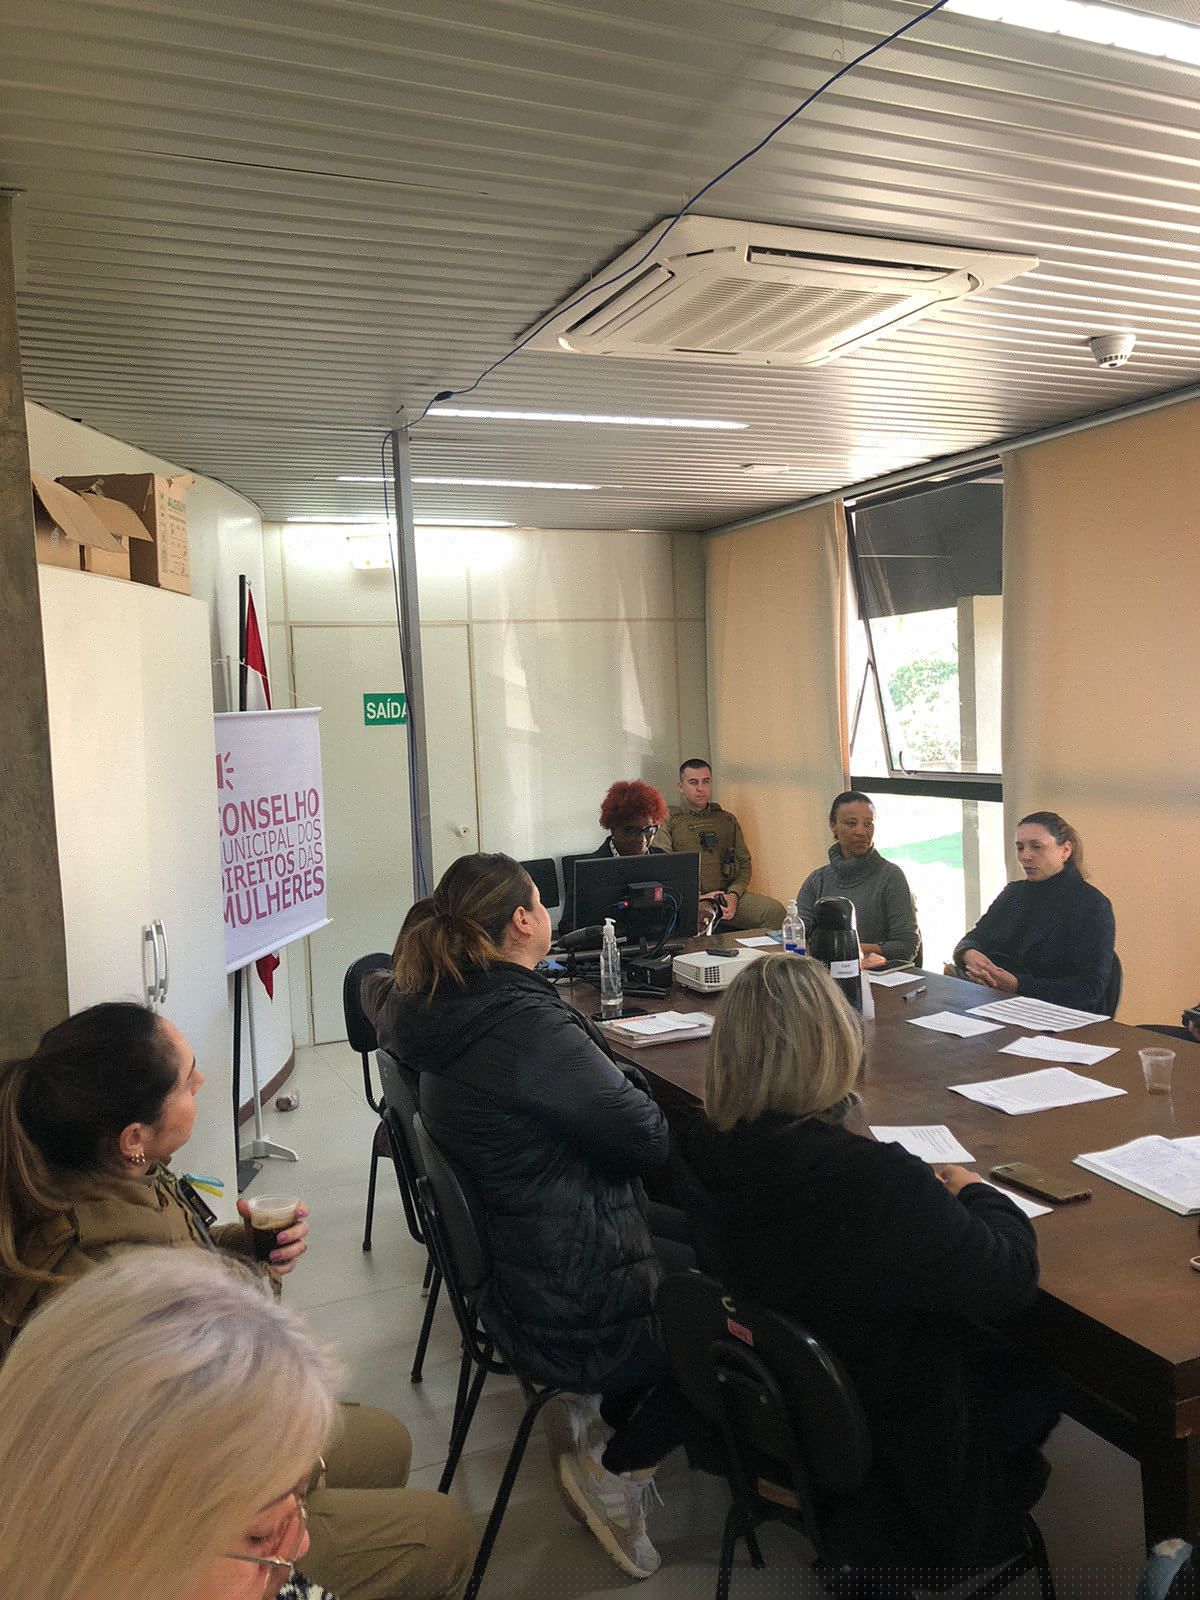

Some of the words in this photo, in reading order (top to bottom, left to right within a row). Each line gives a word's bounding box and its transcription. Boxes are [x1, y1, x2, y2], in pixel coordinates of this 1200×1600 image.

[219, 787, 319, 837] ONSELHO
[222, 829, 294, 865] UNICIPAL
[298, 818, 321, 845] DOS
[298, 841, 323, 870] DAS
